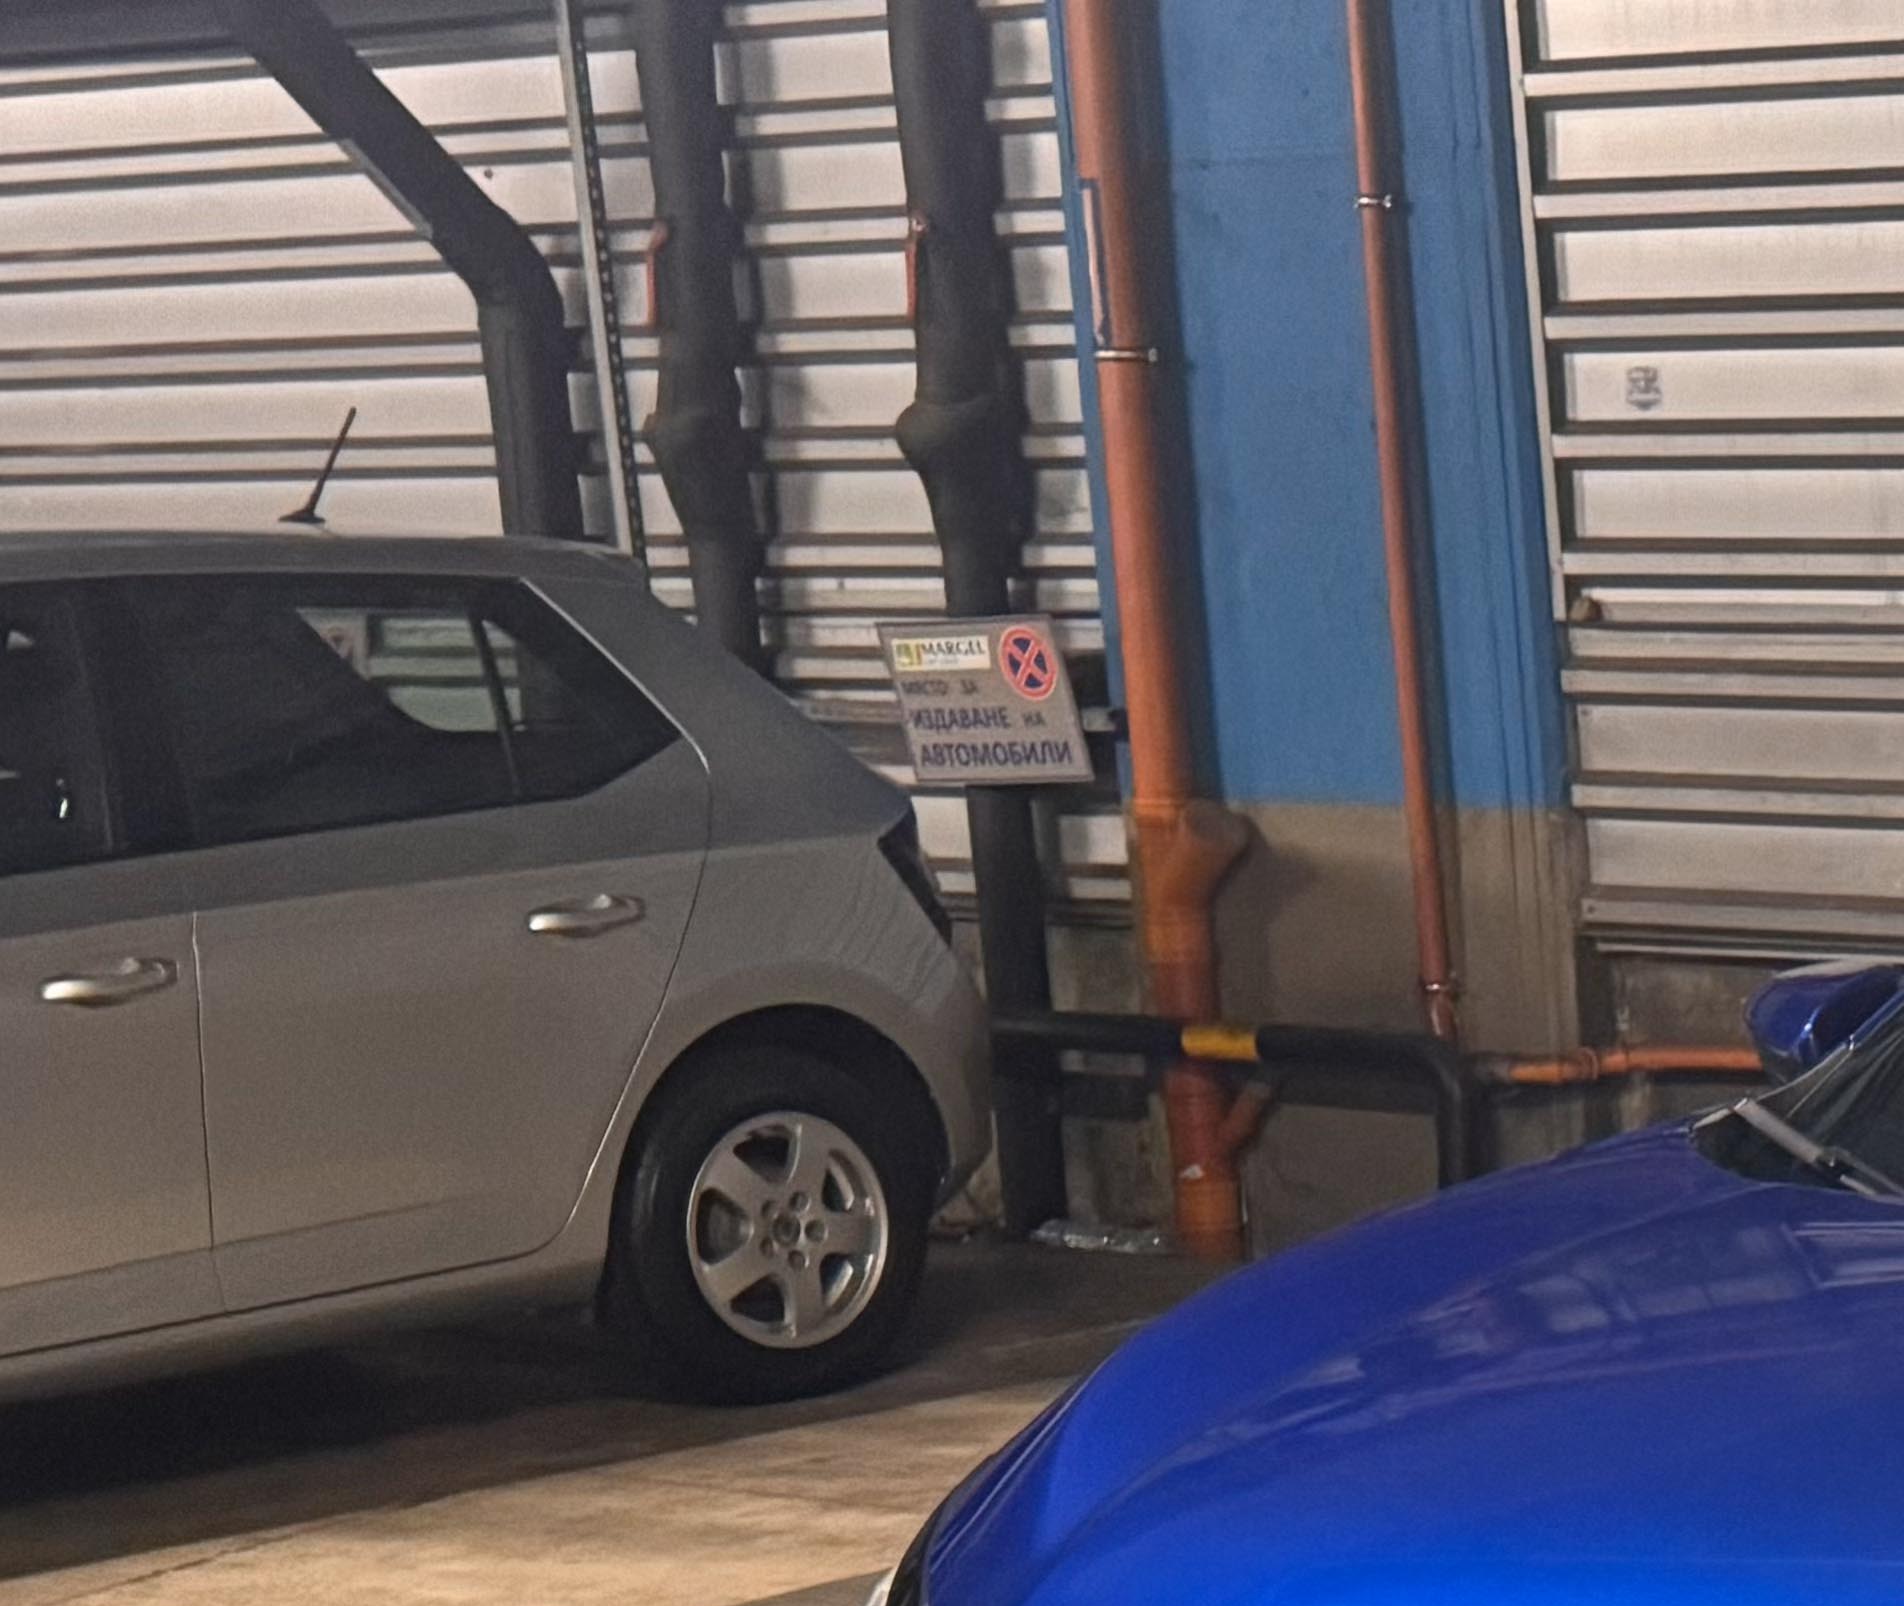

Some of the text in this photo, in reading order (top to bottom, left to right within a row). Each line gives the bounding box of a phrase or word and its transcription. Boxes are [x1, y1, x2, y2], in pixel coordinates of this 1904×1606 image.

[912, 707, 1046, 732] ИЗДАВАНЕ НА
[921, 740, 1073, 767] АВТОМОБИЛИ
